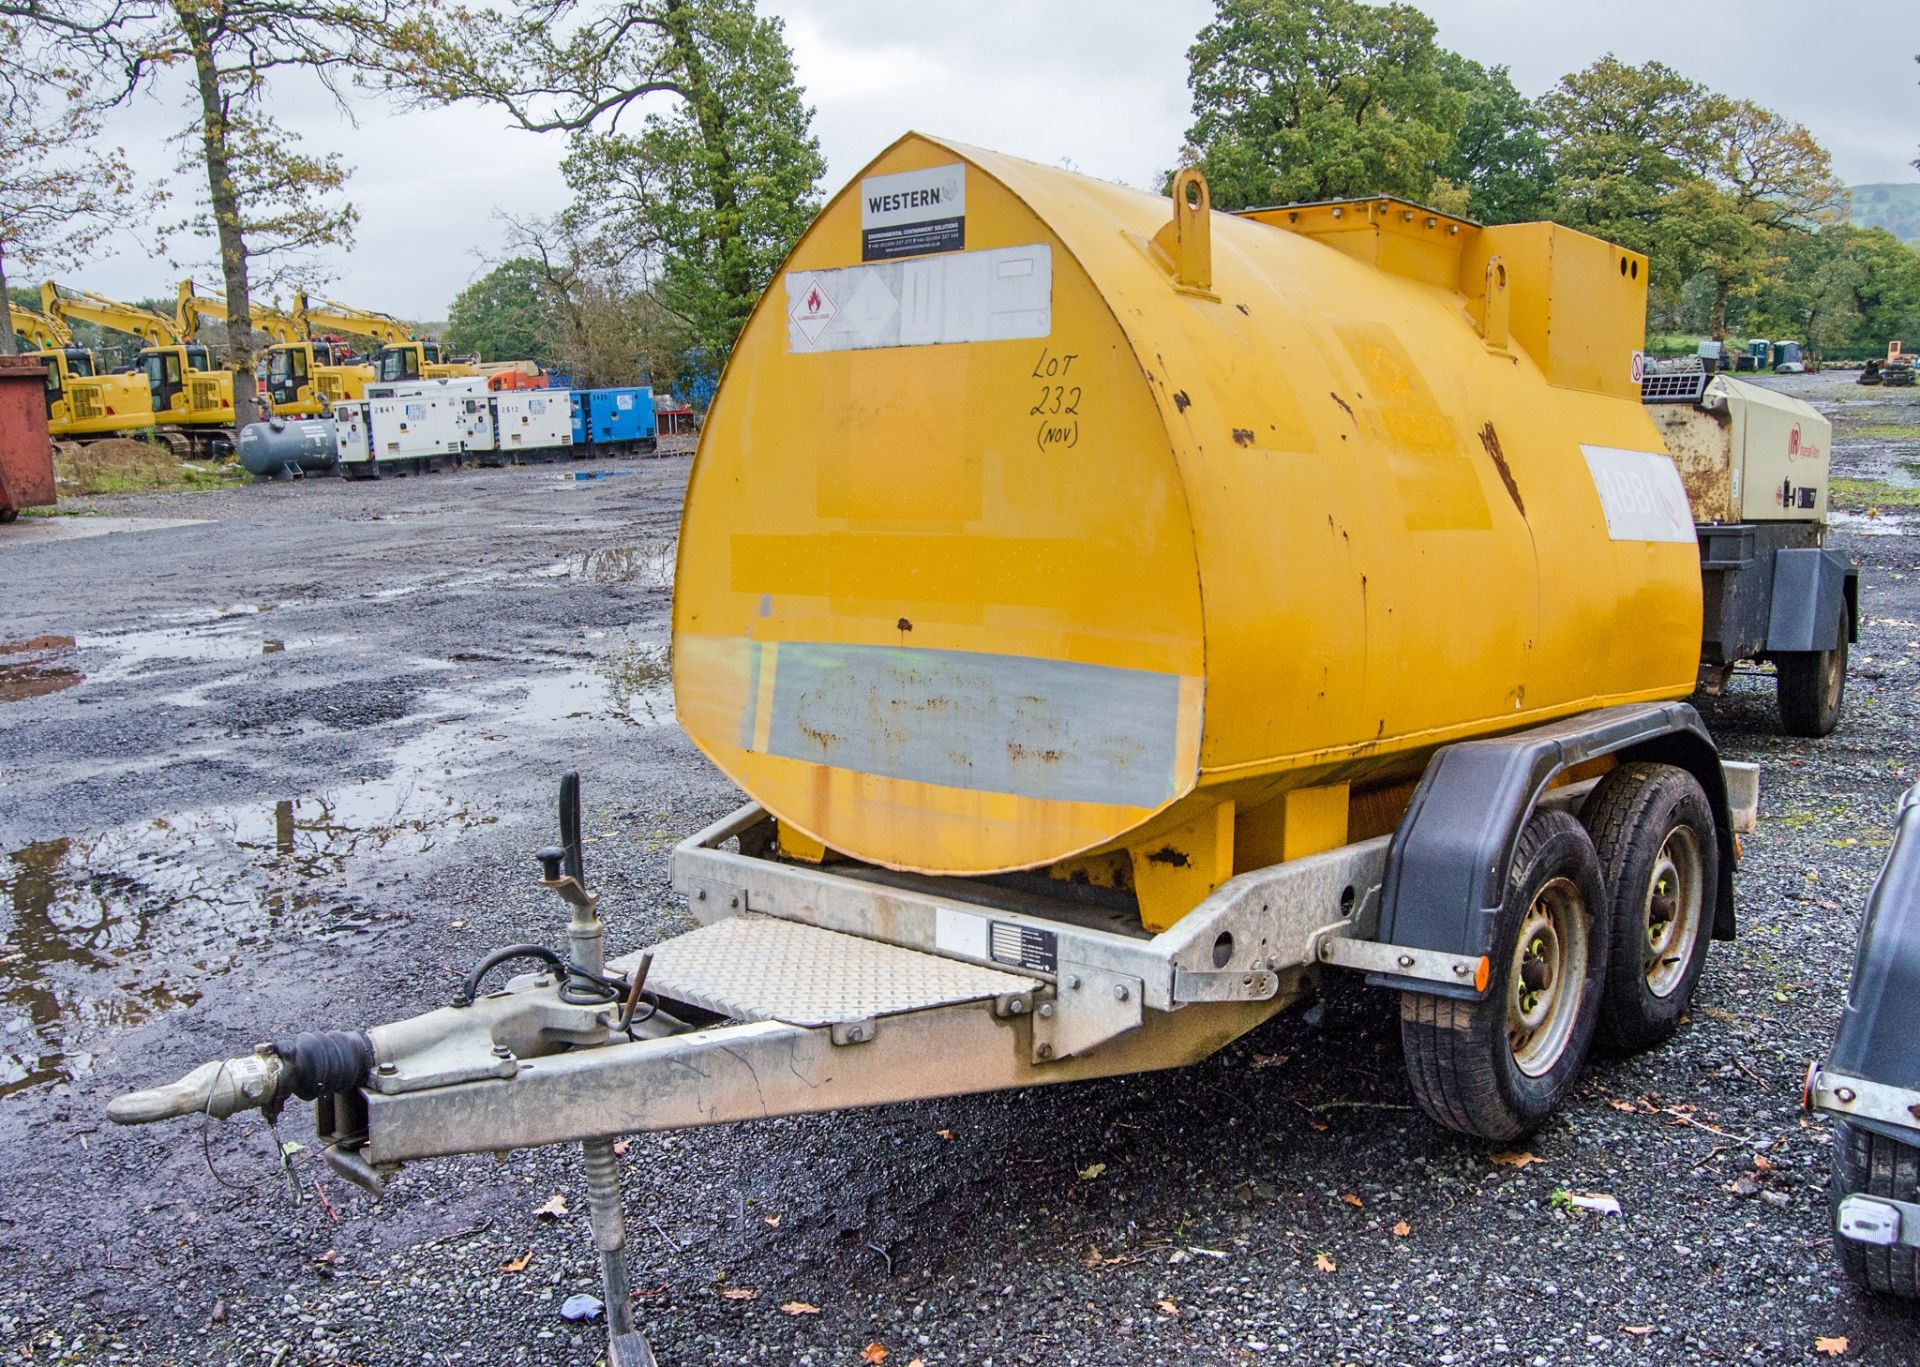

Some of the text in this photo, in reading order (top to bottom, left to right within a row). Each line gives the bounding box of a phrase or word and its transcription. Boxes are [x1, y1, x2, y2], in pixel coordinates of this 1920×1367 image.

[869, 187, 940, 214] WESTERN
[868, 222, 959, 240] ENVIRONMENTAL CONTAINMENT SOLUTIONS
[1032, 347, 1079, 378] LOT
[1030, 386, 1081, 416] 232
[1037, 420, 1078, 453] (NOV)
